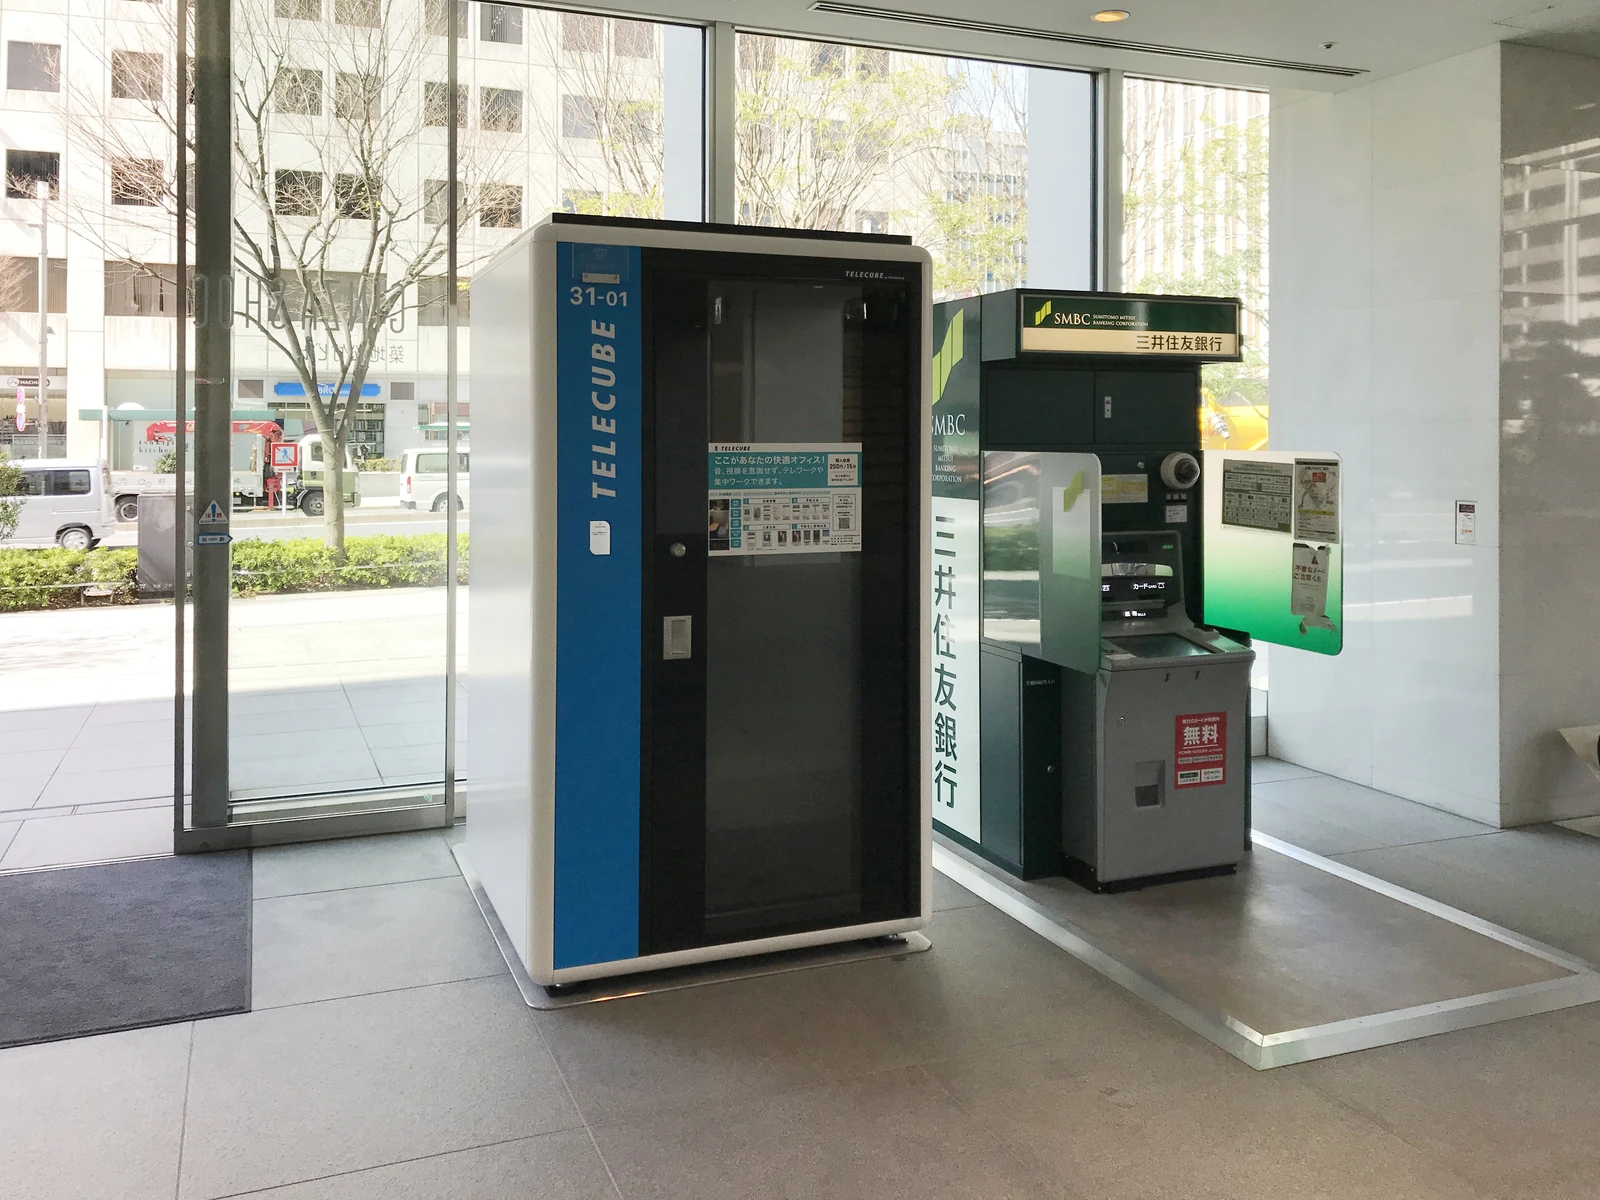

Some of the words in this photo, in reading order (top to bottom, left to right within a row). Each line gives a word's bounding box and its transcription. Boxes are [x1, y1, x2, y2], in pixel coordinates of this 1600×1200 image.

[845, 270, 884, 279] TELECUBE
[570, 286, 628, 307] 31-01
[1054, 312, 1091, 326] SMBC
[1136, 335, 1222, 352] 三井住友銀行
[591, 319, 616, 499] TELECUBE
[933, 444, 959, 453] SUMITOMO
[937, 455, 954, 463] MITSUI
[935, 464, 957, 473] BANKING
[714, 477, 783, 487] 集中ワークできます。
[932, 474, 963, 483] ORPORATION
[933, 515, 957, 809] 三井住友銀行
[1184, 724, 1218, 746] 無料
